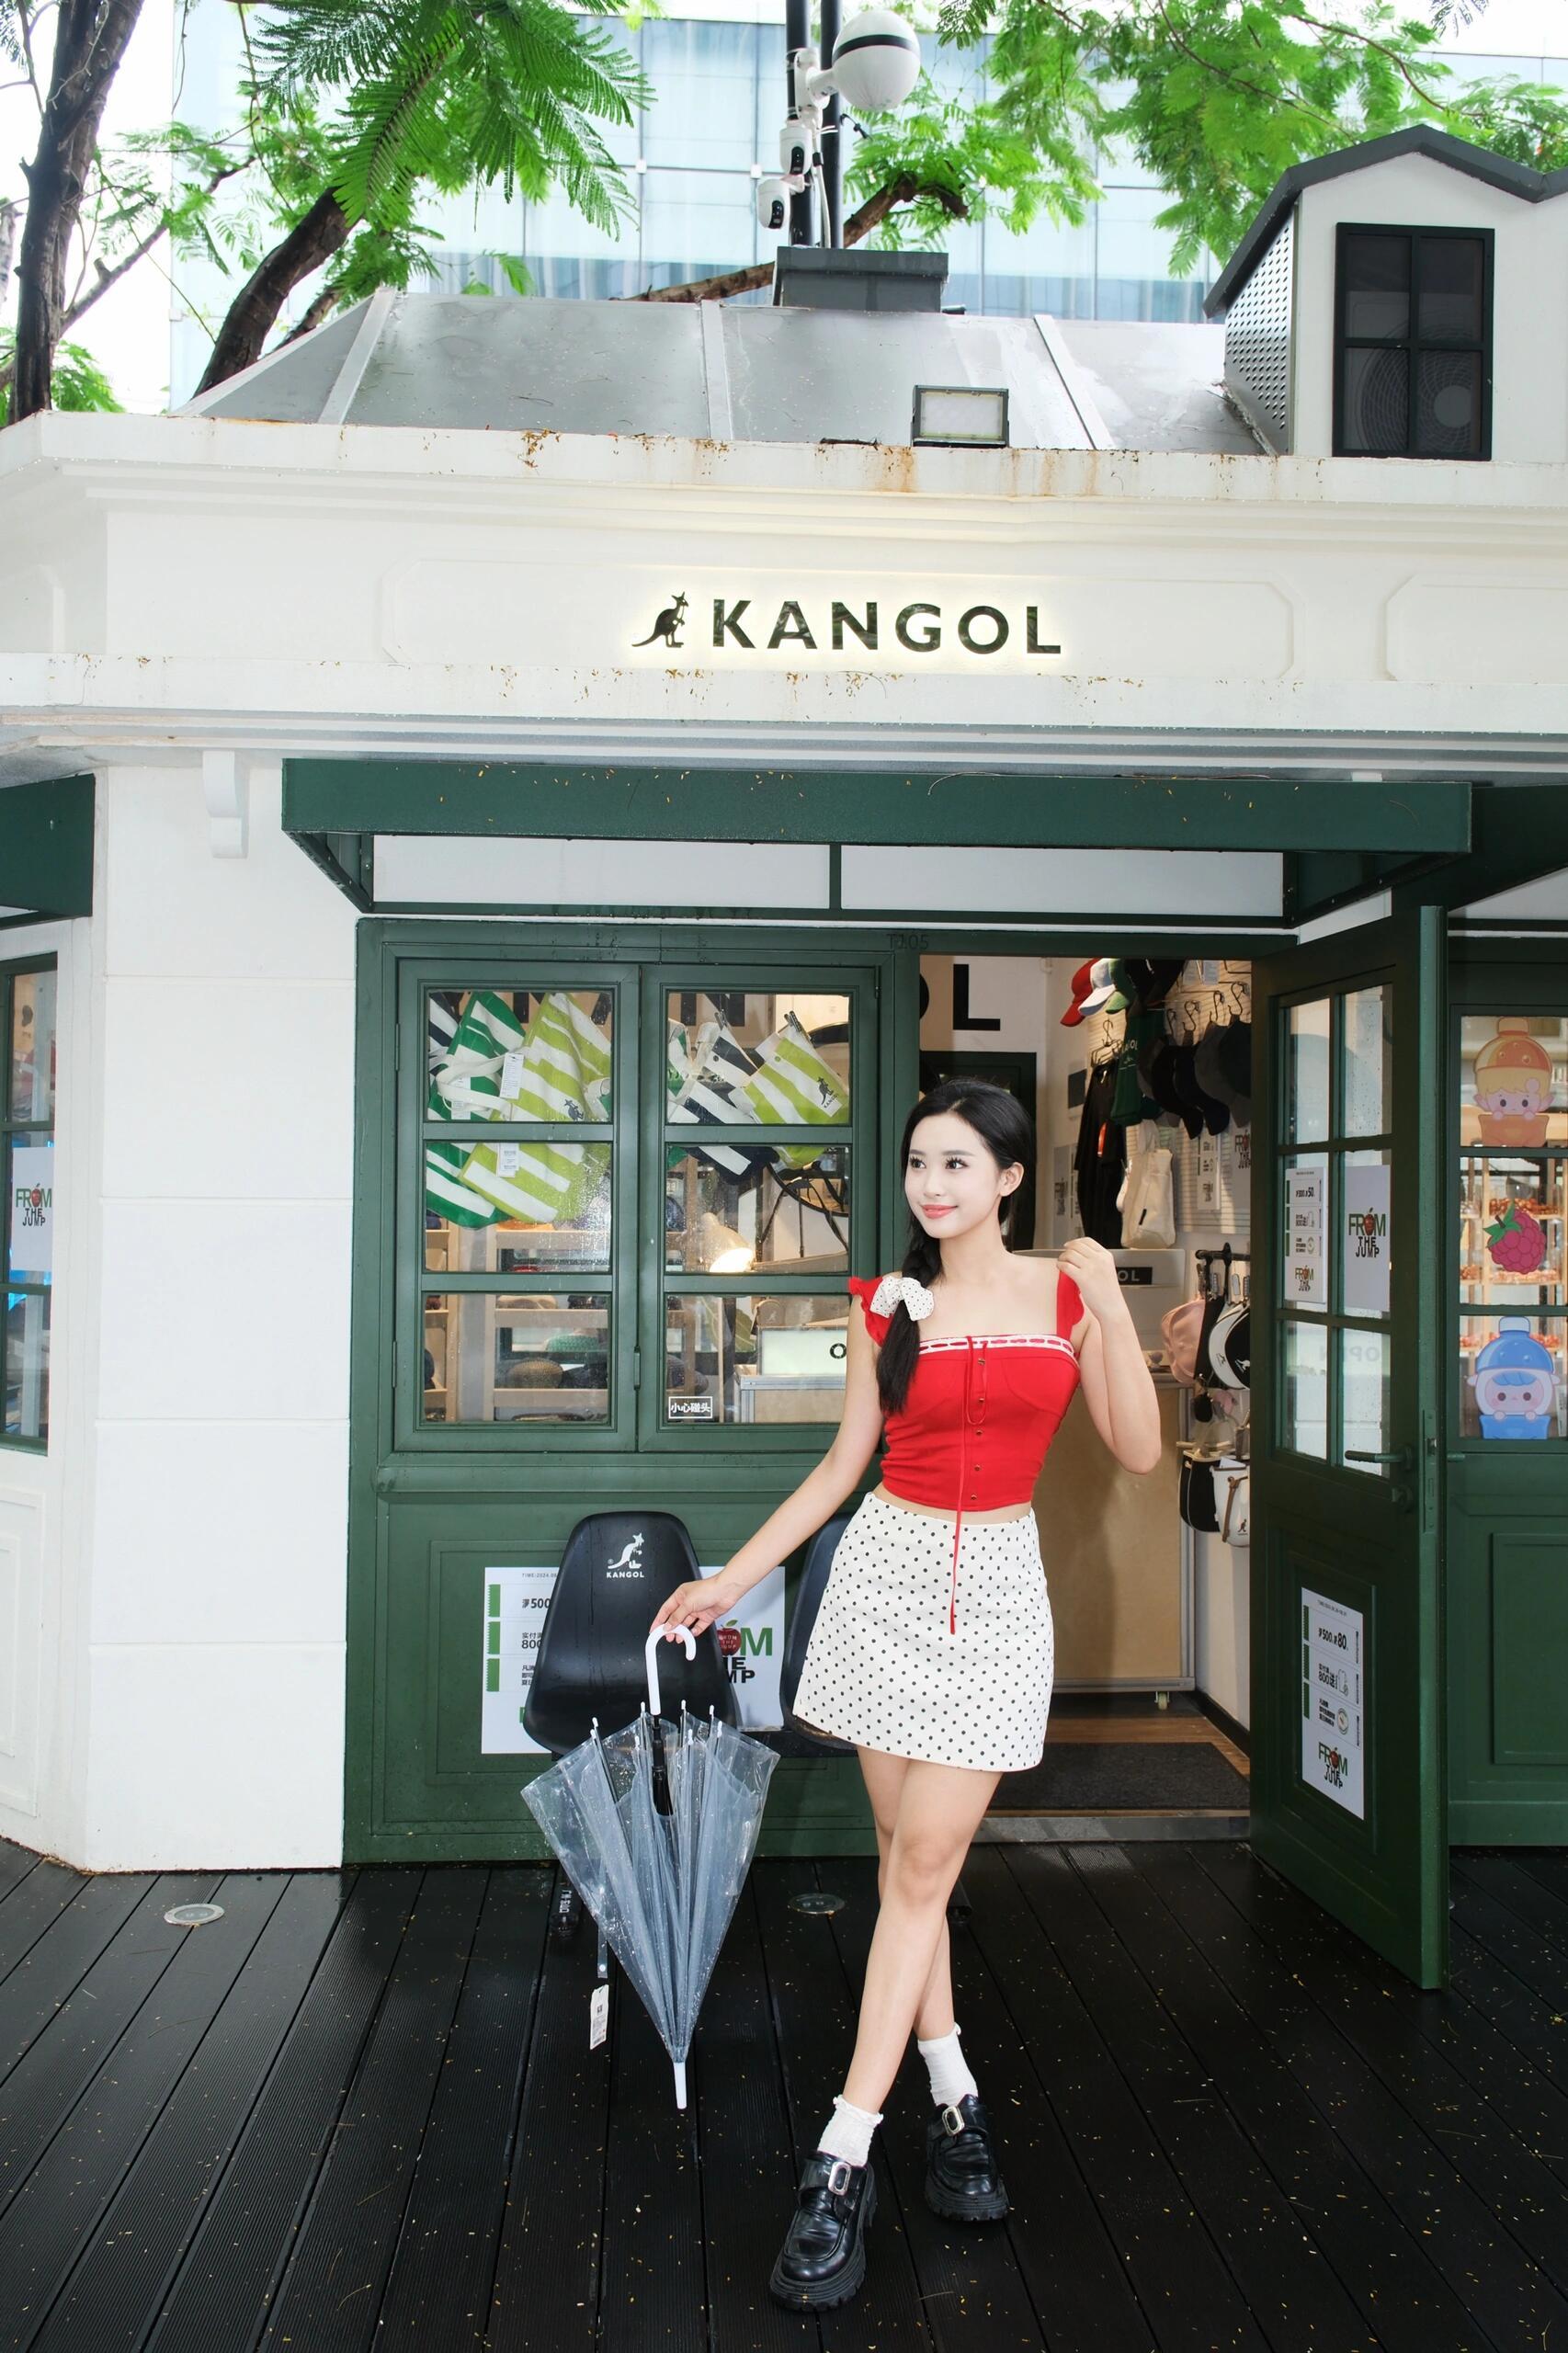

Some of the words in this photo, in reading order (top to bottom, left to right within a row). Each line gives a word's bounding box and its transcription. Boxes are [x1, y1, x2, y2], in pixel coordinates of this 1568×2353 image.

[713, 598, 1062, 654] KANGOL
[25, 1208, 43, 1218] THE
[22, 1217, 46, 1226] JUMP
[1348, 1212, 1386, 1237] FROM
[1358, 1236, 1377, 1247] THE
[1355, 1246, 1381, 1258] JUMP
[606, 1571, 645, 1579] KANGOL
